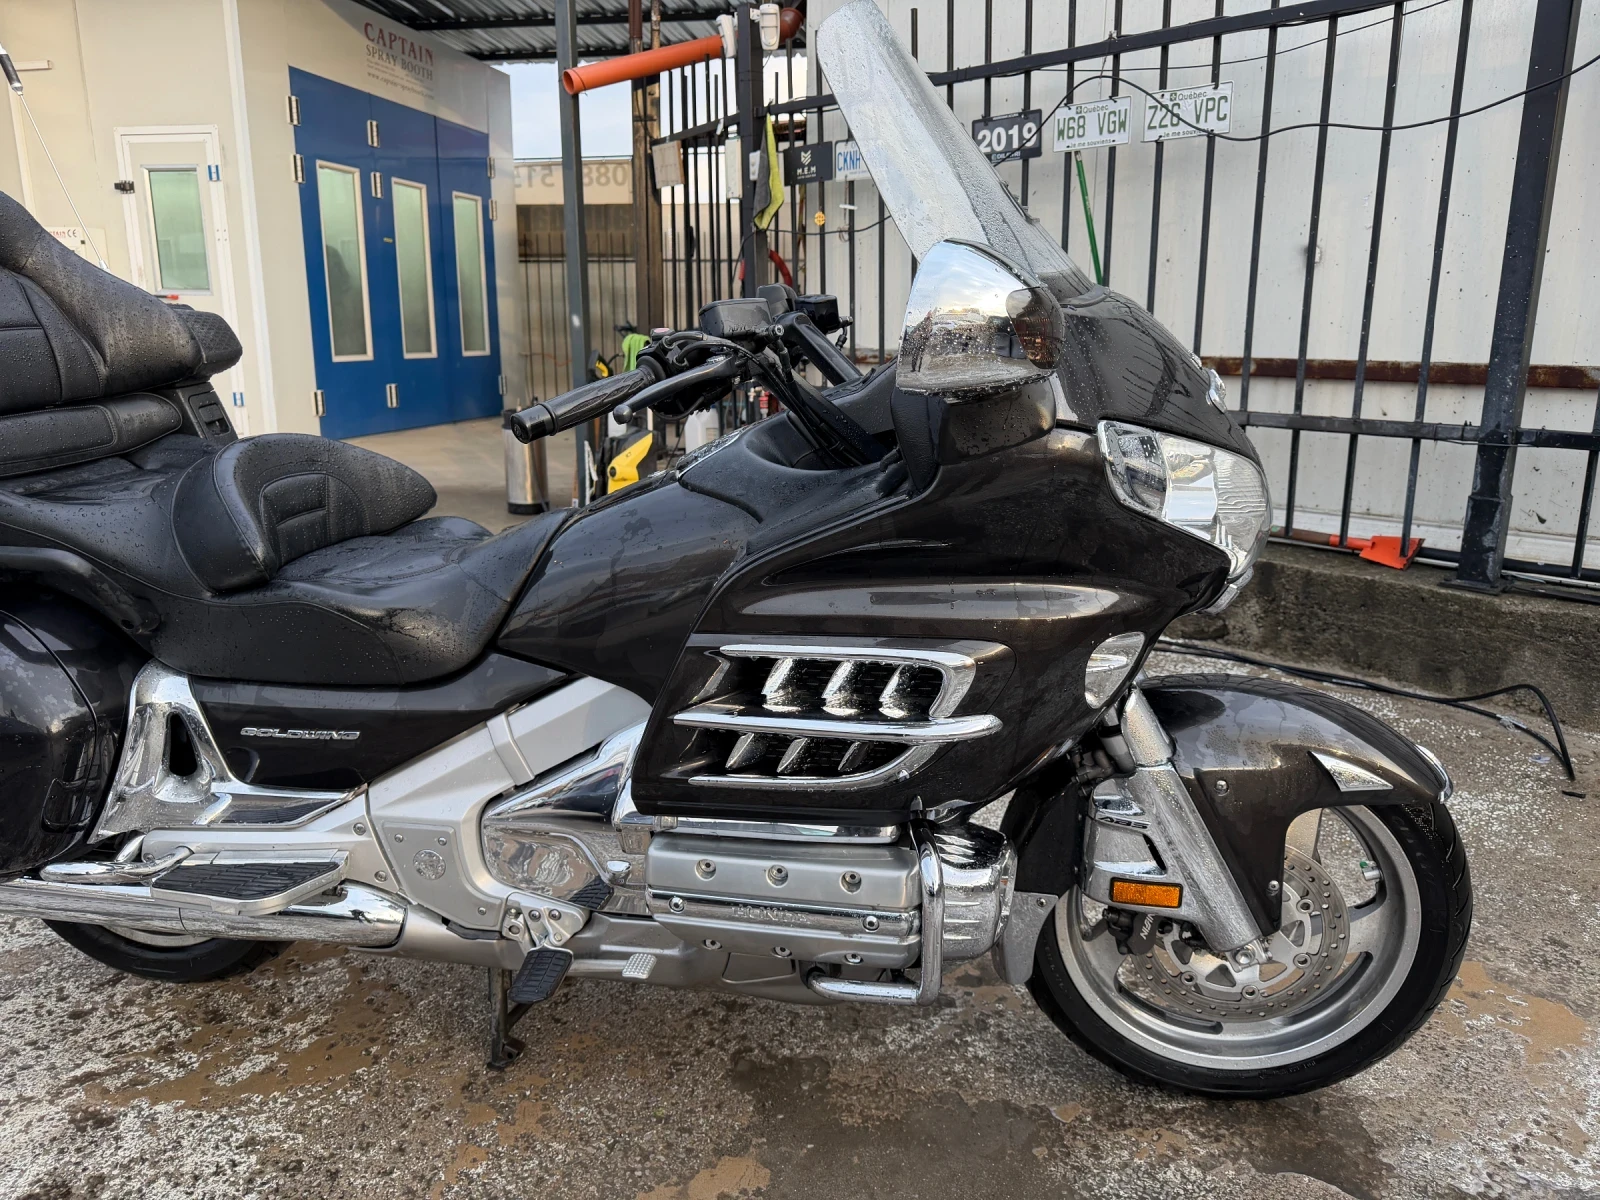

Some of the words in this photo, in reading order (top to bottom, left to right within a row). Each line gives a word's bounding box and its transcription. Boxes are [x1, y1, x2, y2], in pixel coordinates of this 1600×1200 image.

[364, 22, 433, 66] CAPTAIN
[366, 44, 397, 66] SPRAY
[401, 58, 433, 81] BOOTH
[1083, 105, 1109, 114] Québec
[1178, 91, 1207, 100] Québec
[1057, 115, 1086, 141] W68
[1098, 108, 1128, 136] VGW
[1148, 102, 1181, 130] Z26
[1194, 95, 1228, 124] VPC
[977, 121, 1037, 153] 2019
[1098, 816, 1150, 829] ABS
[732, 904, 812, 924] HONDA
